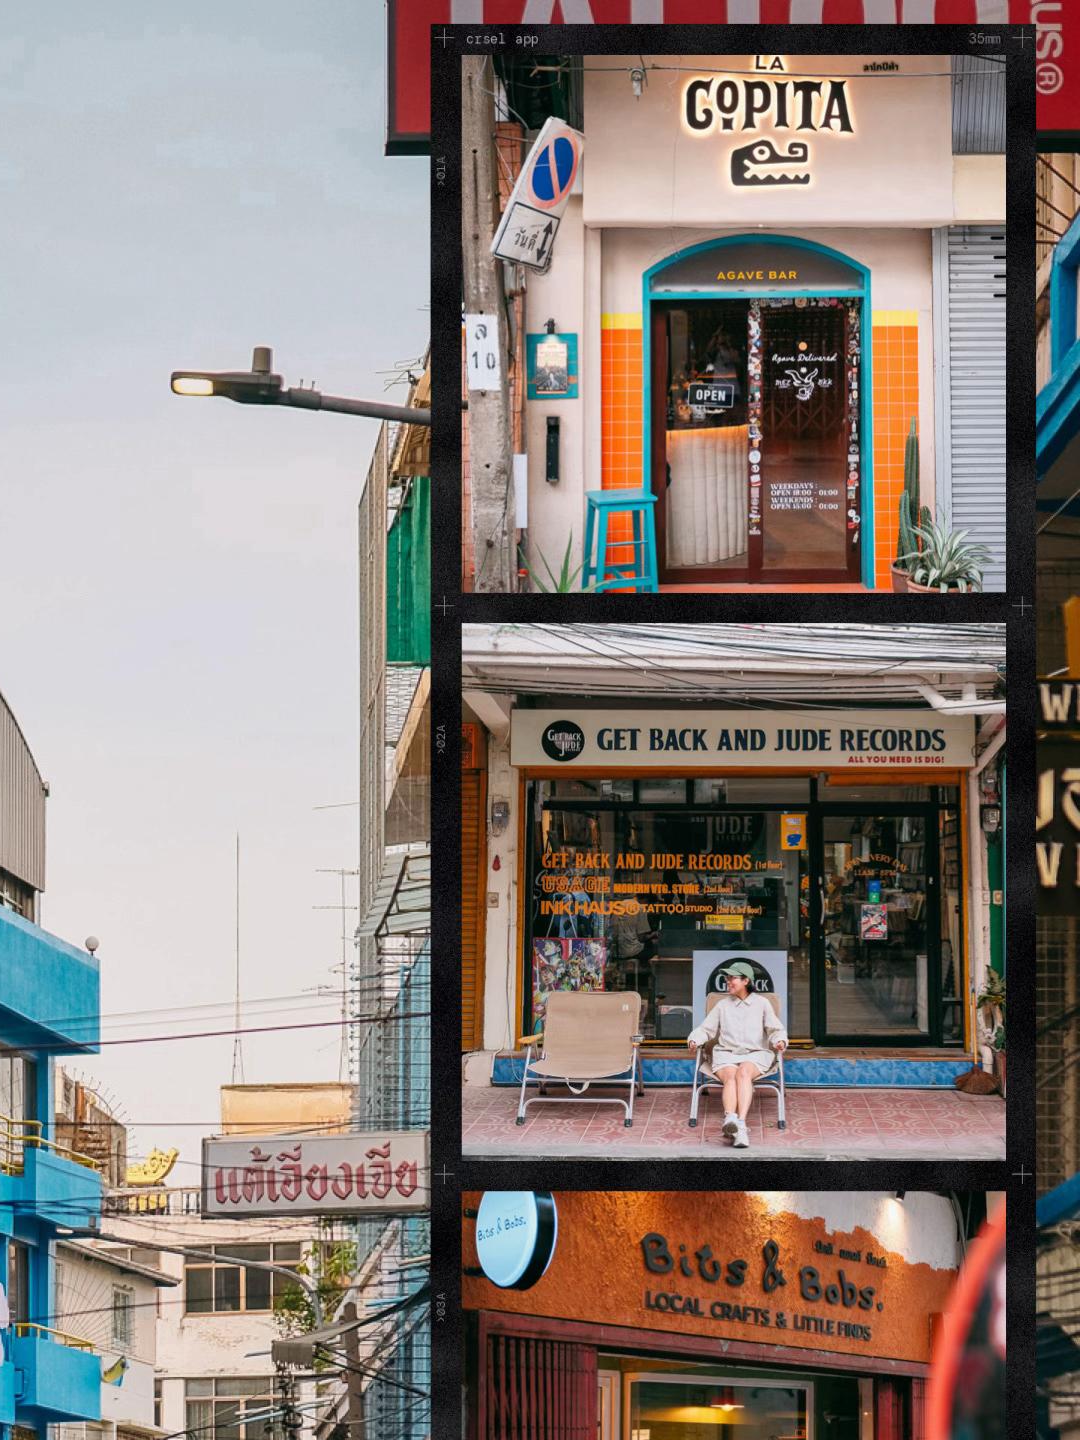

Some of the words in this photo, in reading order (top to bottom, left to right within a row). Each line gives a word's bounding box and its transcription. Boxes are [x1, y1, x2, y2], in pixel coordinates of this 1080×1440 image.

[755, 55, 784, 71] LA
[717, 270, 764, 281] AGAVE
[768, 270, 798, 280] BAR
[472, 351, 497, 370] 10
[695, 388, 726, 402] OPEN
[596, 728, 641, 752] GET
[649, 728, 708, 752] BACK
[717, 728, 767, 752] AND
[774, 729, 832, 752] JUDE
[840, 729, 947, 752] RECORDS
[848, 755, 864, 764] ALL
[866, 755, 886, 764] YOU
[888, 755, 912, 764] NEED
[914, 755, 923, 764] IS
[925, 755, 945, 764] DIG!
[542, 853, 569, 870] GET
[576, 853, 610, 870] BACK
[616, 853, 645, 870] AND
[649, 853, 684, 870] JUDE
[688, 853, 752, 870] RECORDS
[641, 1231, 748, 1286] Bits
[762, 1238, 787, 1293] &
[645, 1290, 705, 1316] LOCAL
[710, 1300, 770, 1327] CRAFTS
[775, 1311, 788, 1329] &
[793, 1313, 835, 1337] LITTLE
[837, 1320, 872, 1341] FINDS
